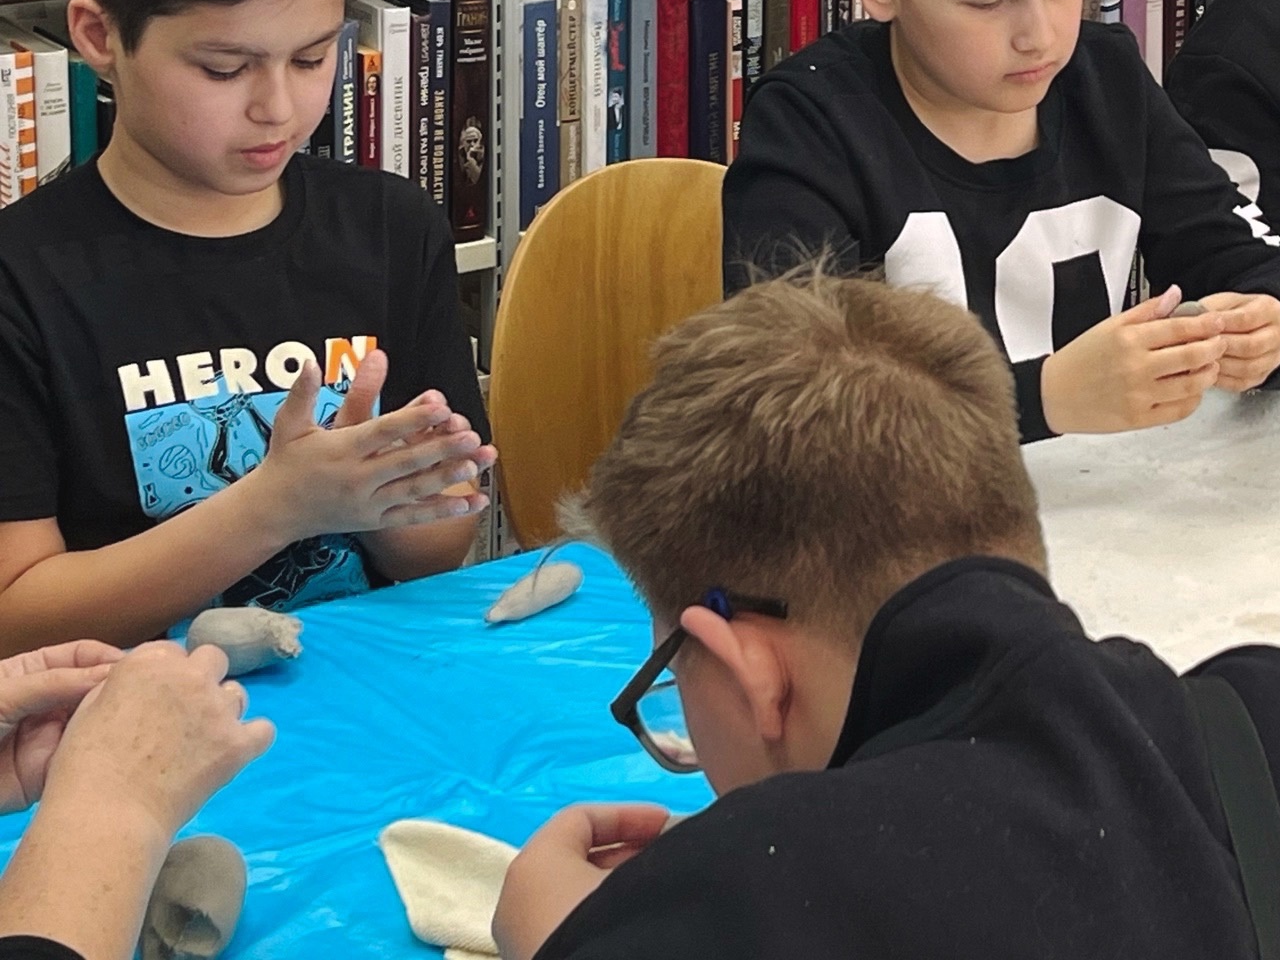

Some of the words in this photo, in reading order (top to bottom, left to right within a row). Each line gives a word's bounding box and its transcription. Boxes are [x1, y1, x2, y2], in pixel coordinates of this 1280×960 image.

[536, 20, 547, 57] шахтёр
[536, 60, 545, 80] мой
[393, 75, 404, 139] дневник
[434, 90, 445, 125] ЗАКОНУ
[536, 83, 547, 107] Отец
[343, 83, 354, 156] ГРАНИН
[435, 129, 444, 141] НЕ
